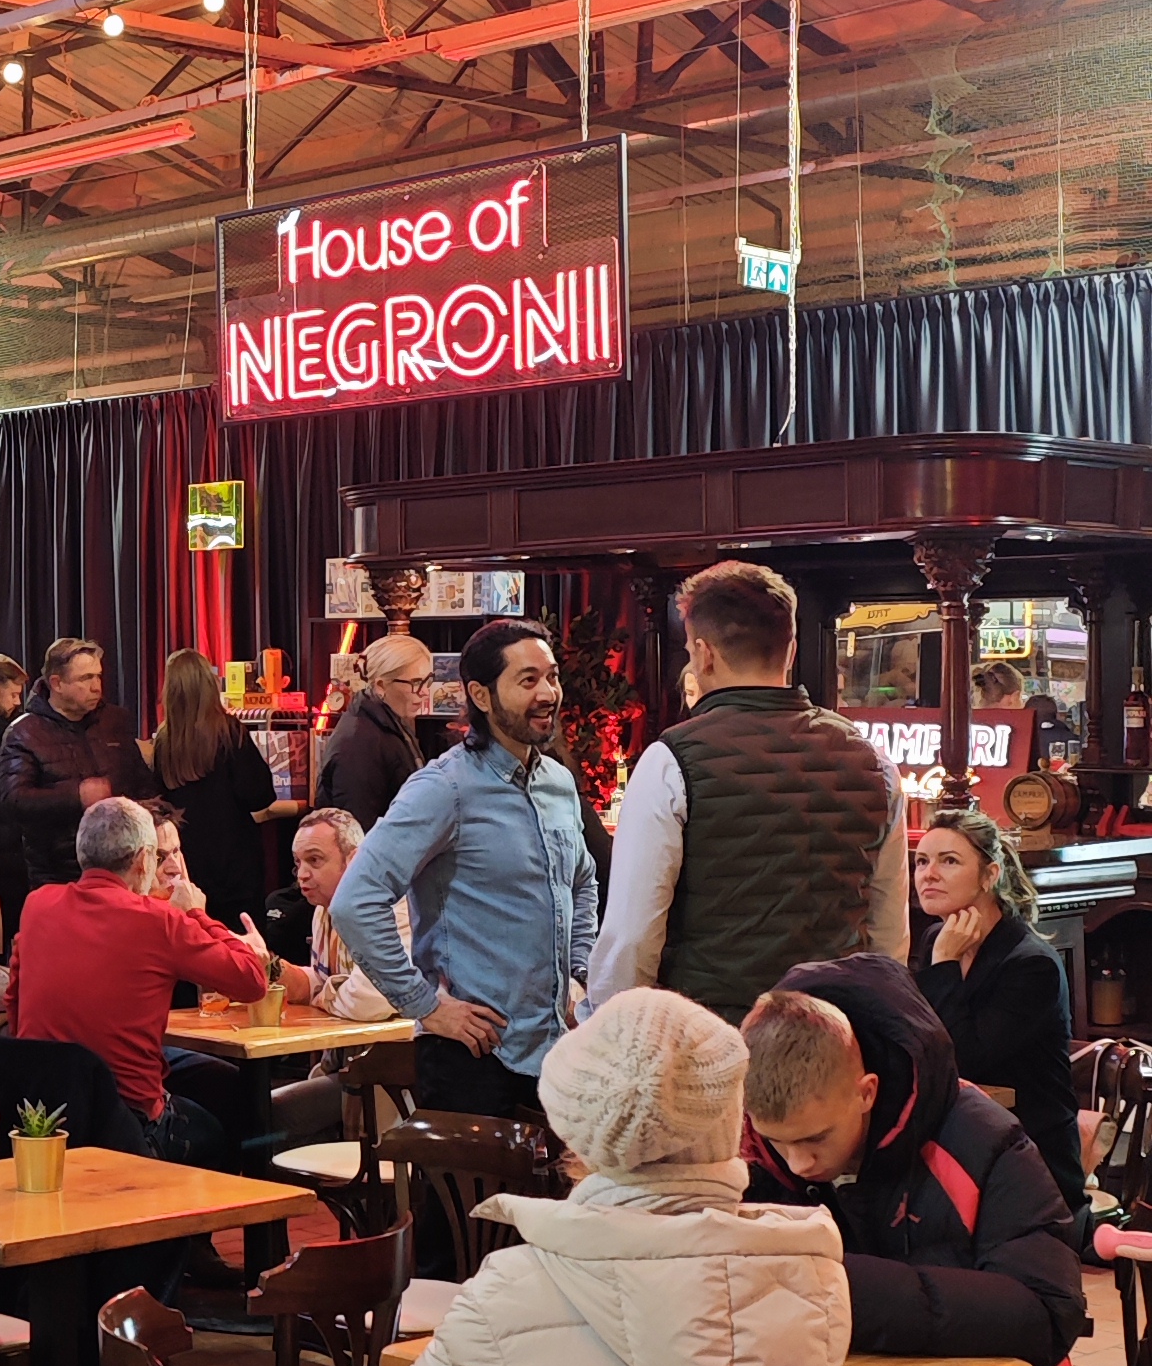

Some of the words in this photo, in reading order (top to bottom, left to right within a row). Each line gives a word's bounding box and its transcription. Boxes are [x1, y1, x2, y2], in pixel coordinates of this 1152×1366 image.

[286, 212, 453, 284] House
[468, 179, 532, 252] of
[228, 263, 611, 407] NEGRONI
[853, 721, 1012, 766] AMPRI
